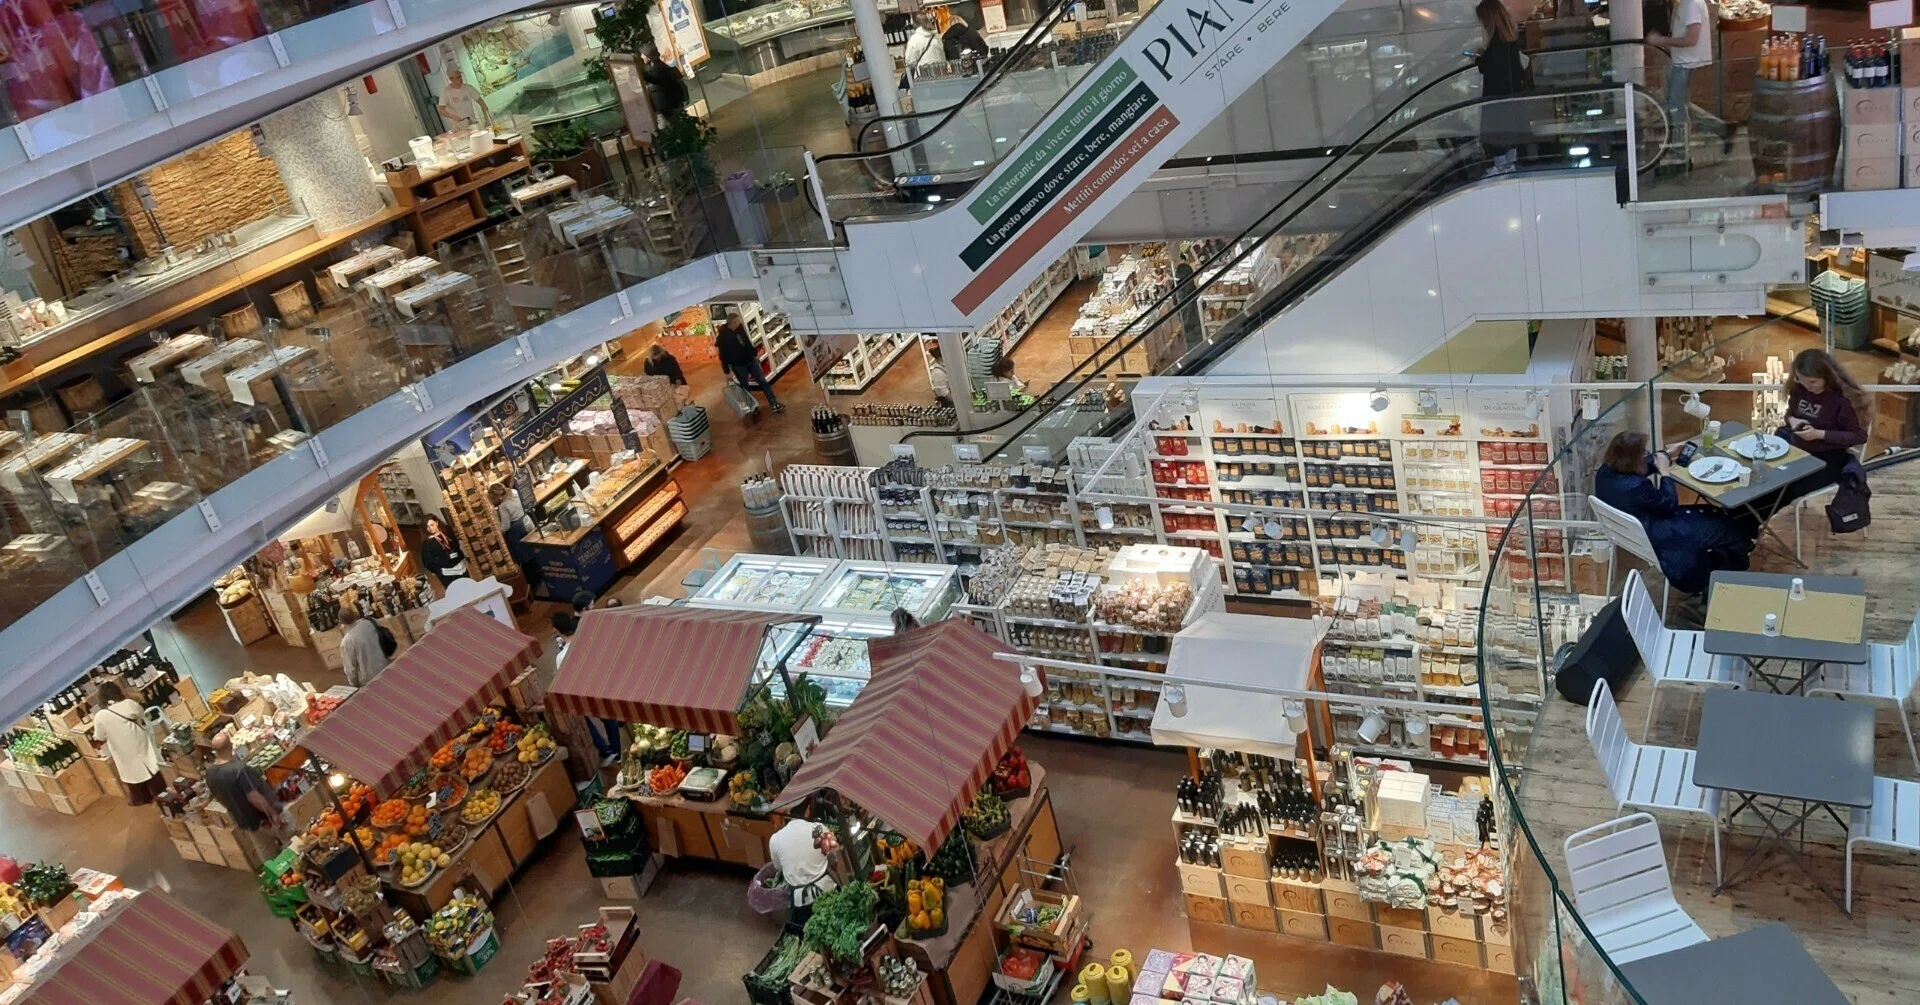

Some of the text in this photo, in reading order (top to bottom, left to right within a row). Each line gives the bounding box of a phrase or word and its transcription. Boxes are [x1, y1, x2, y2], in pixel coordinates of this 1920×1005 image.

[1205, 1, 1291, 80] STARE BERE
[985, 71, 1127, 207] Un ristorante da vivere tutto il giorno
[985, 93, 1148, 246] Un posto nuovo dove stare, bere, mangiare
[1062, 117, 1170, 215] Mettiti comodo: sei a casa
[1799, 399, 1822, 415] EA7
